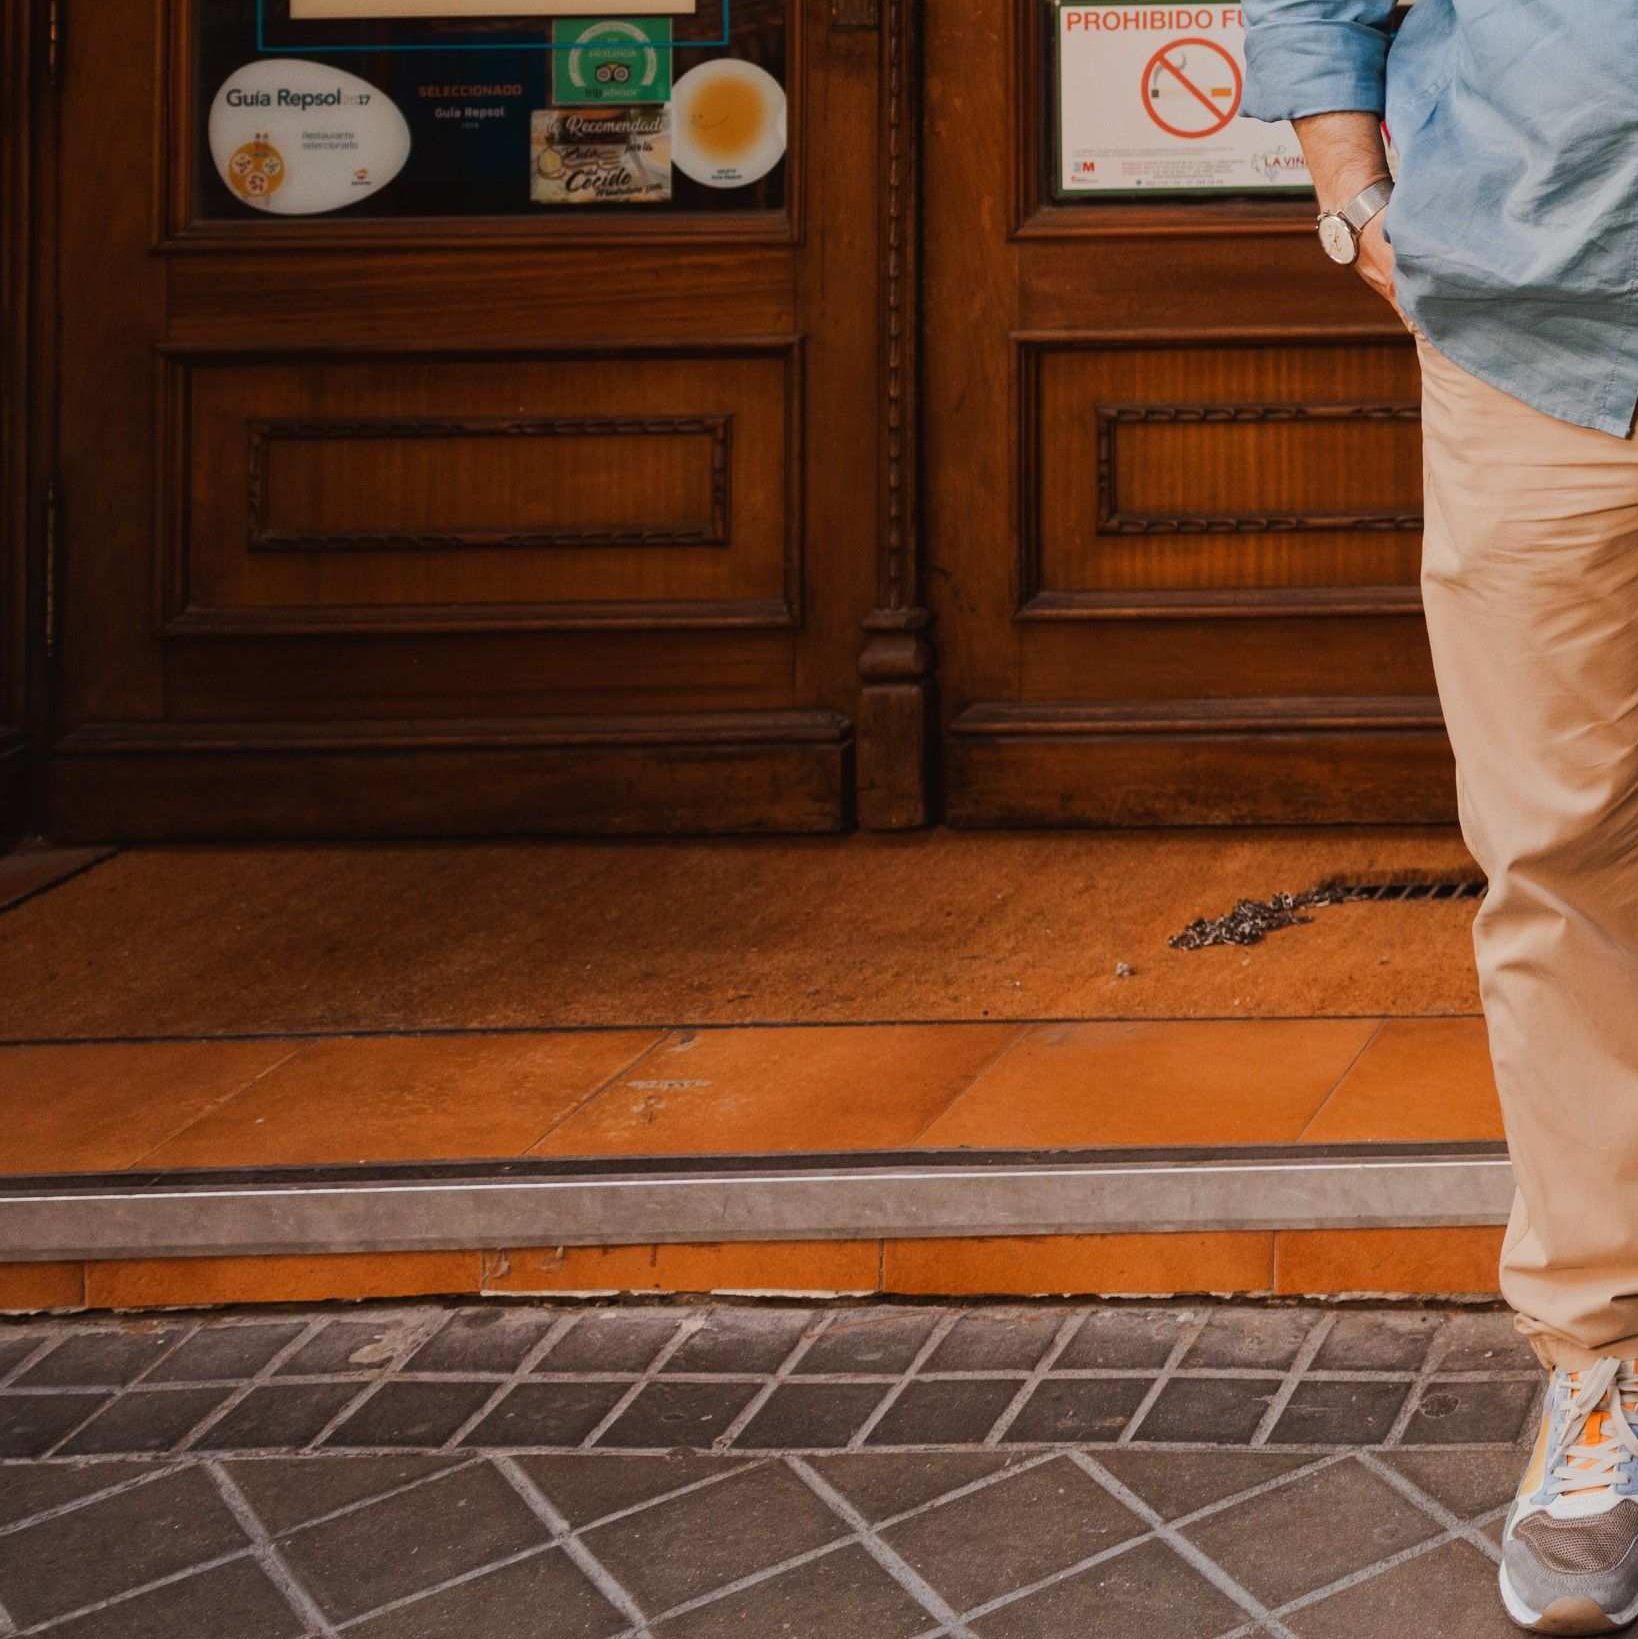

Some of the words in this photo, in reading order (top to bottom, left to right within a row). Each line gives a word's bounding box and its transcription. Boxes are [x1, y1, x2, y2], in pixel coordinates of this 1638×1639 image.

[1066, 8, 1214, 31] PROHIBIDO
[226, 88, 271, 108] Guía
[276, 88, 341, 111] Repsol
[418, 84, 522, 98] SELECCIONADO
[464, 106, 505, 119] Repsol
